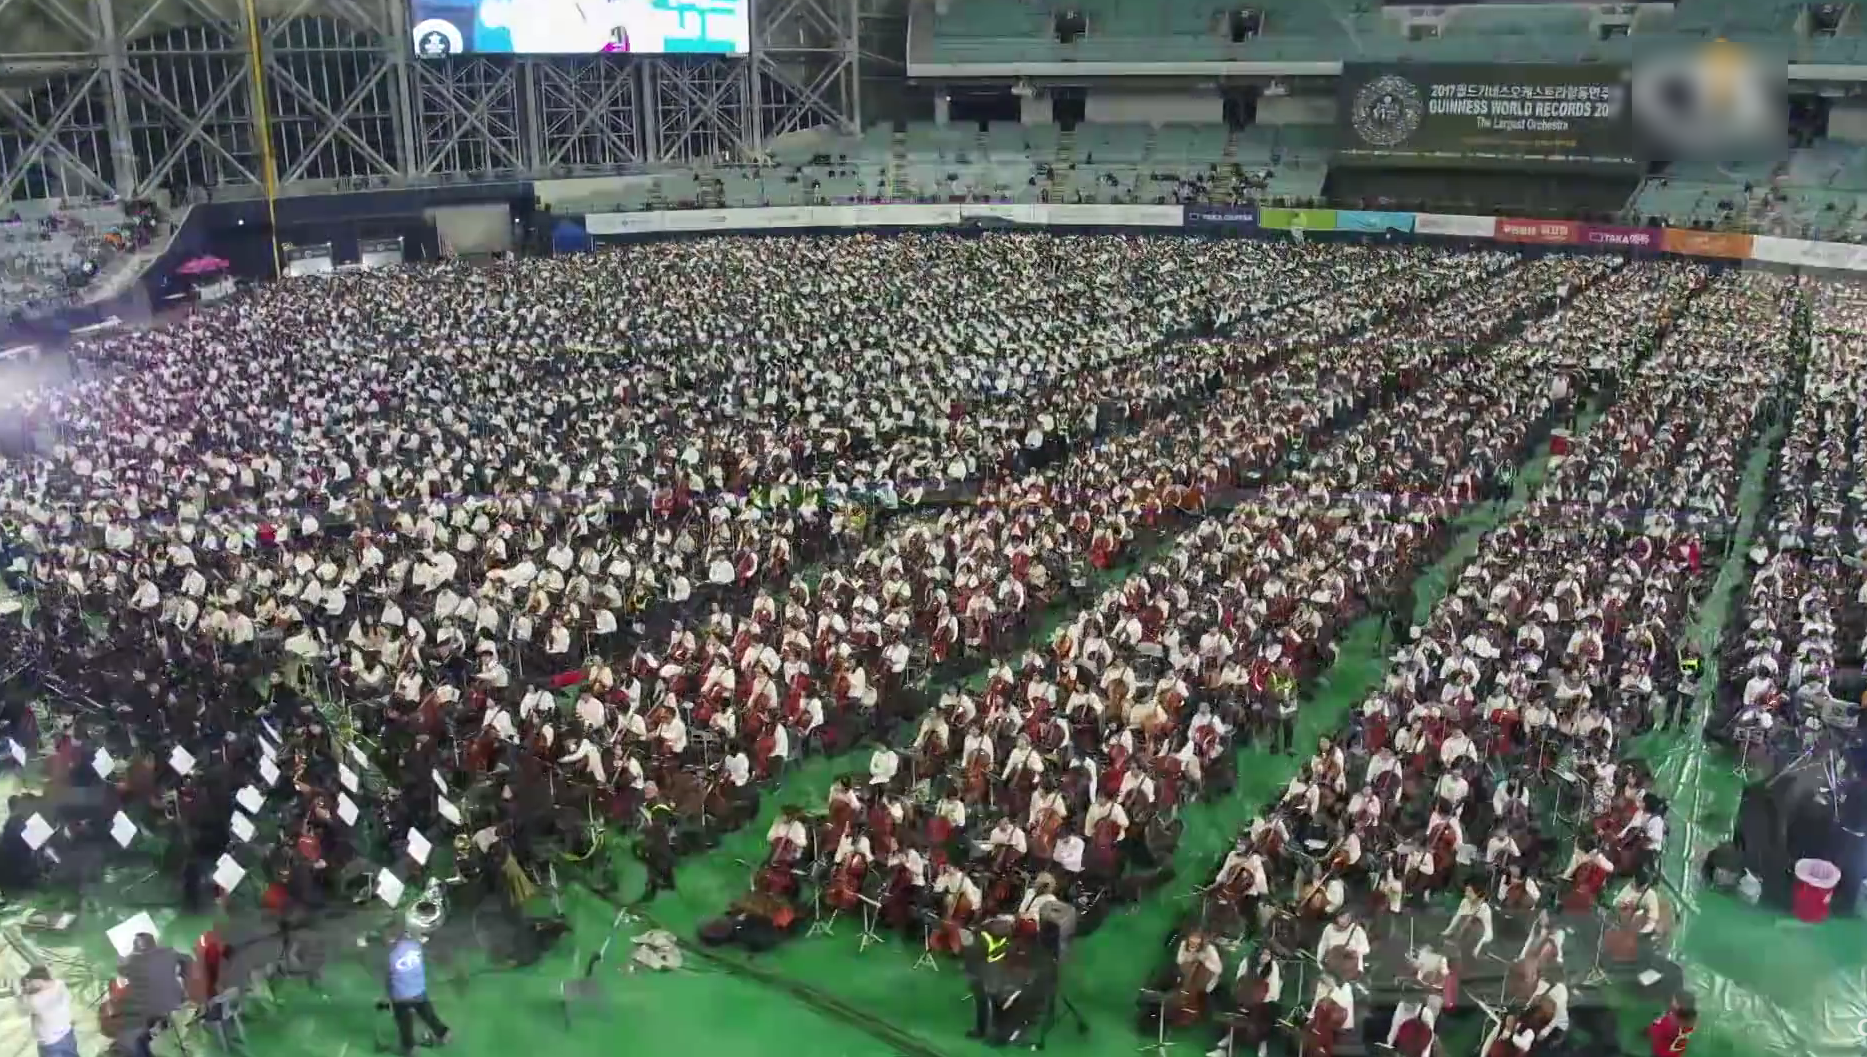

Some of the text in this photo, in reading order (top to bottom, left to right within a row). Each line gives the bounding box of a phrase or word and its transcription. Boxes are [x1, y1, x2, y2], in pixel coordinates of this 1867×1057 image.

[1429, 98, 1488, 115] GUINNESS
[1491, 99, 1532, 116] WORLD
[1535, 101, 1591, 117] RECORDS
[1477, 116, 1568, 131] The Largest Orchestra
